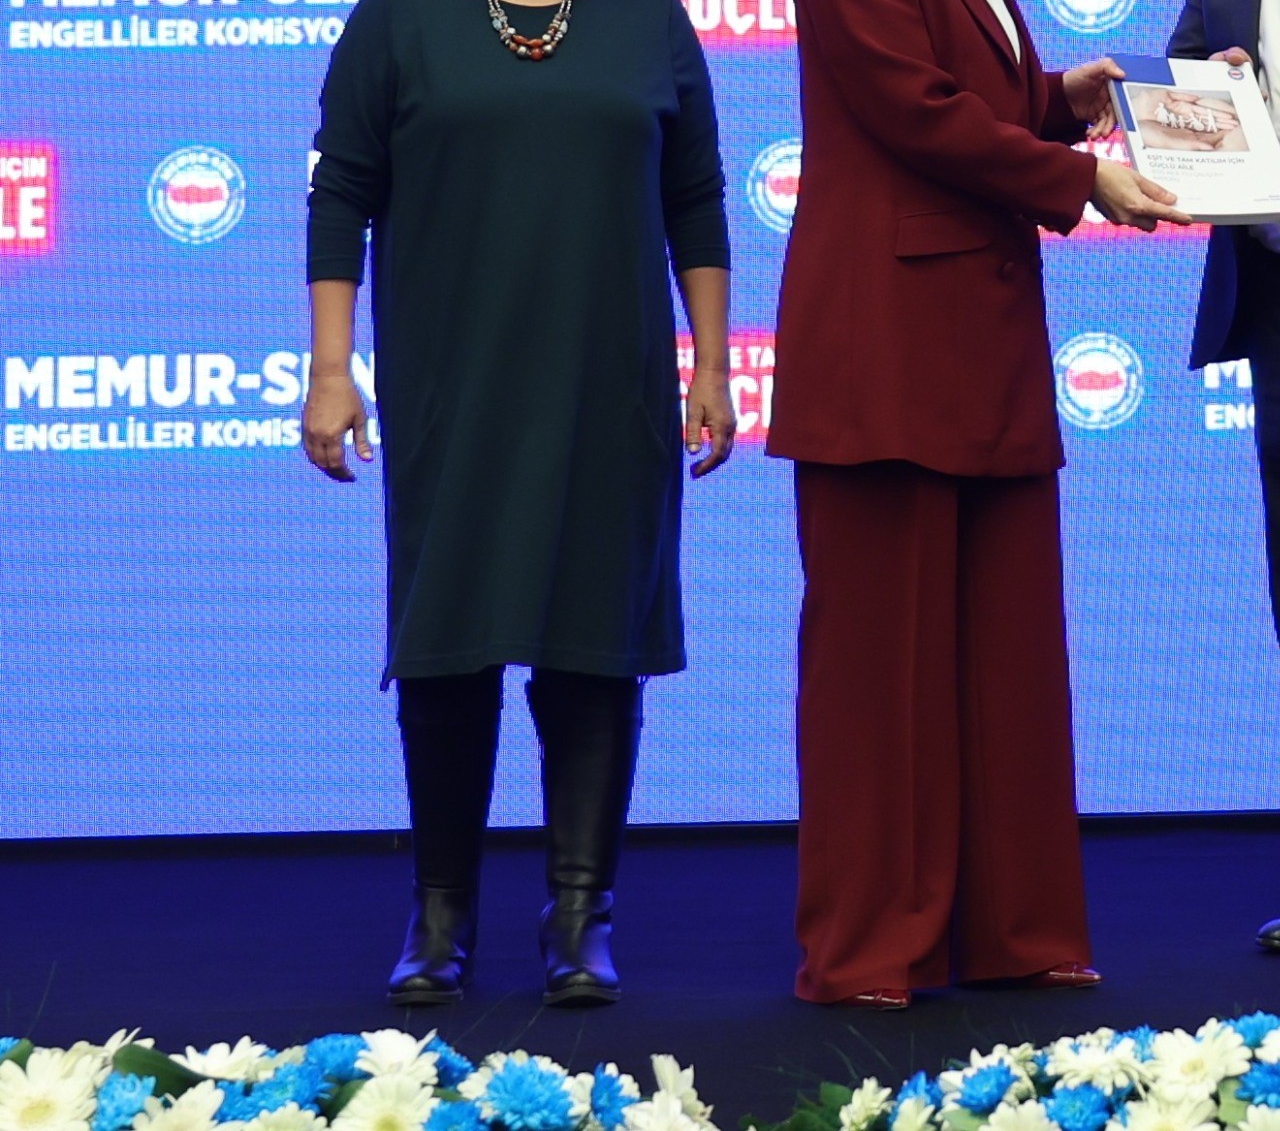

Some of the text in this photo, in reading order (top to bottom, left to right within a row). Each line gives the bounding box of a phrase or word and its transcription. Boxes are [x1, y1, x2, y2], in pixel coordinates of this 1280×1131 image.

[10, 15, 344, 47] ENGELLİLER KOMİSYO
[748, 346, 775, 368] TA
[6, 417, 194, 450] ENGELLİLER
